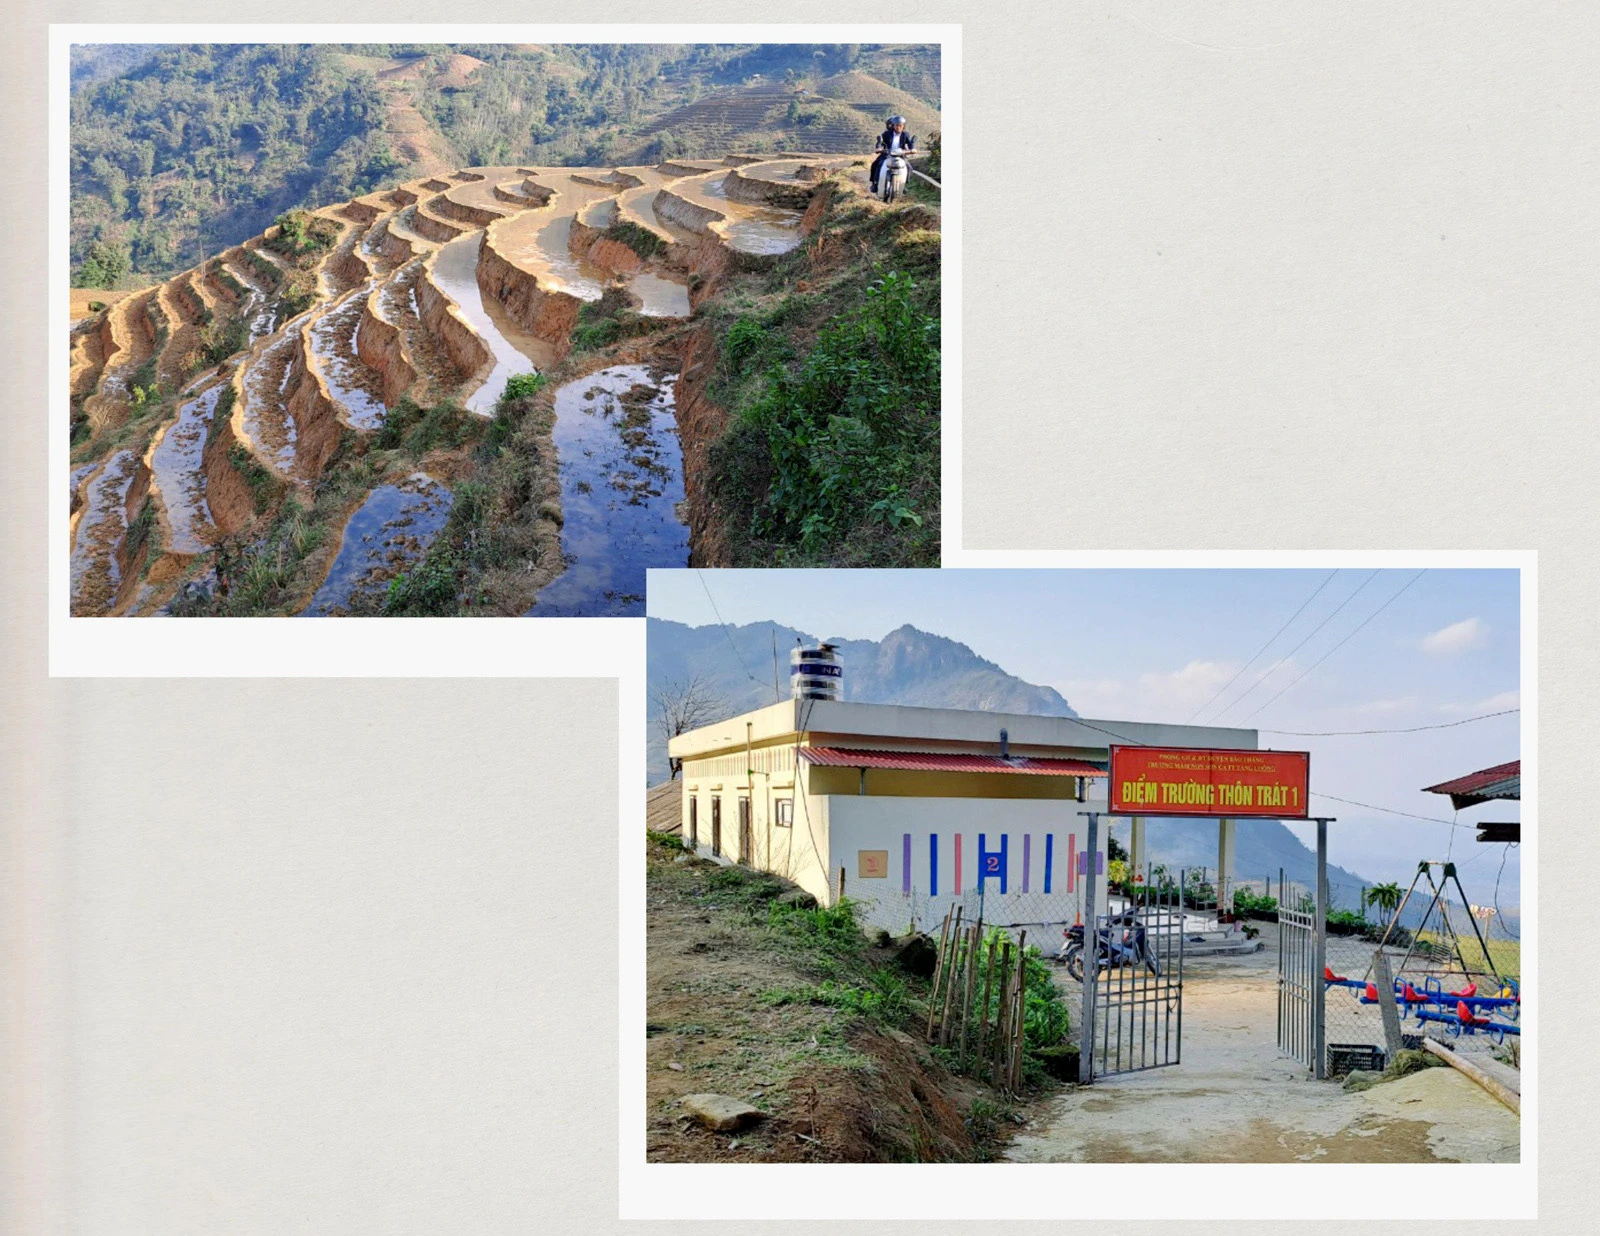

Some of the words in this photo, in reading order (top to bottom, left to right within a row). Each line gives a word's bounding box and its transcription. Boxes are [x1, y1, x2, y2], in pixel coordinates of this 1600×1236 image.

[1122, 773, 1158, 804] ĐIỂM
[1162, 778, 1215, 805] TRƯỜNG
[1218, 780, 1253, 806] THÔN
[1256, 781, 1288, 807] TRÁT
[1292, 786, 1298, 807] 1
[987, 857, 1000, 872] 2
